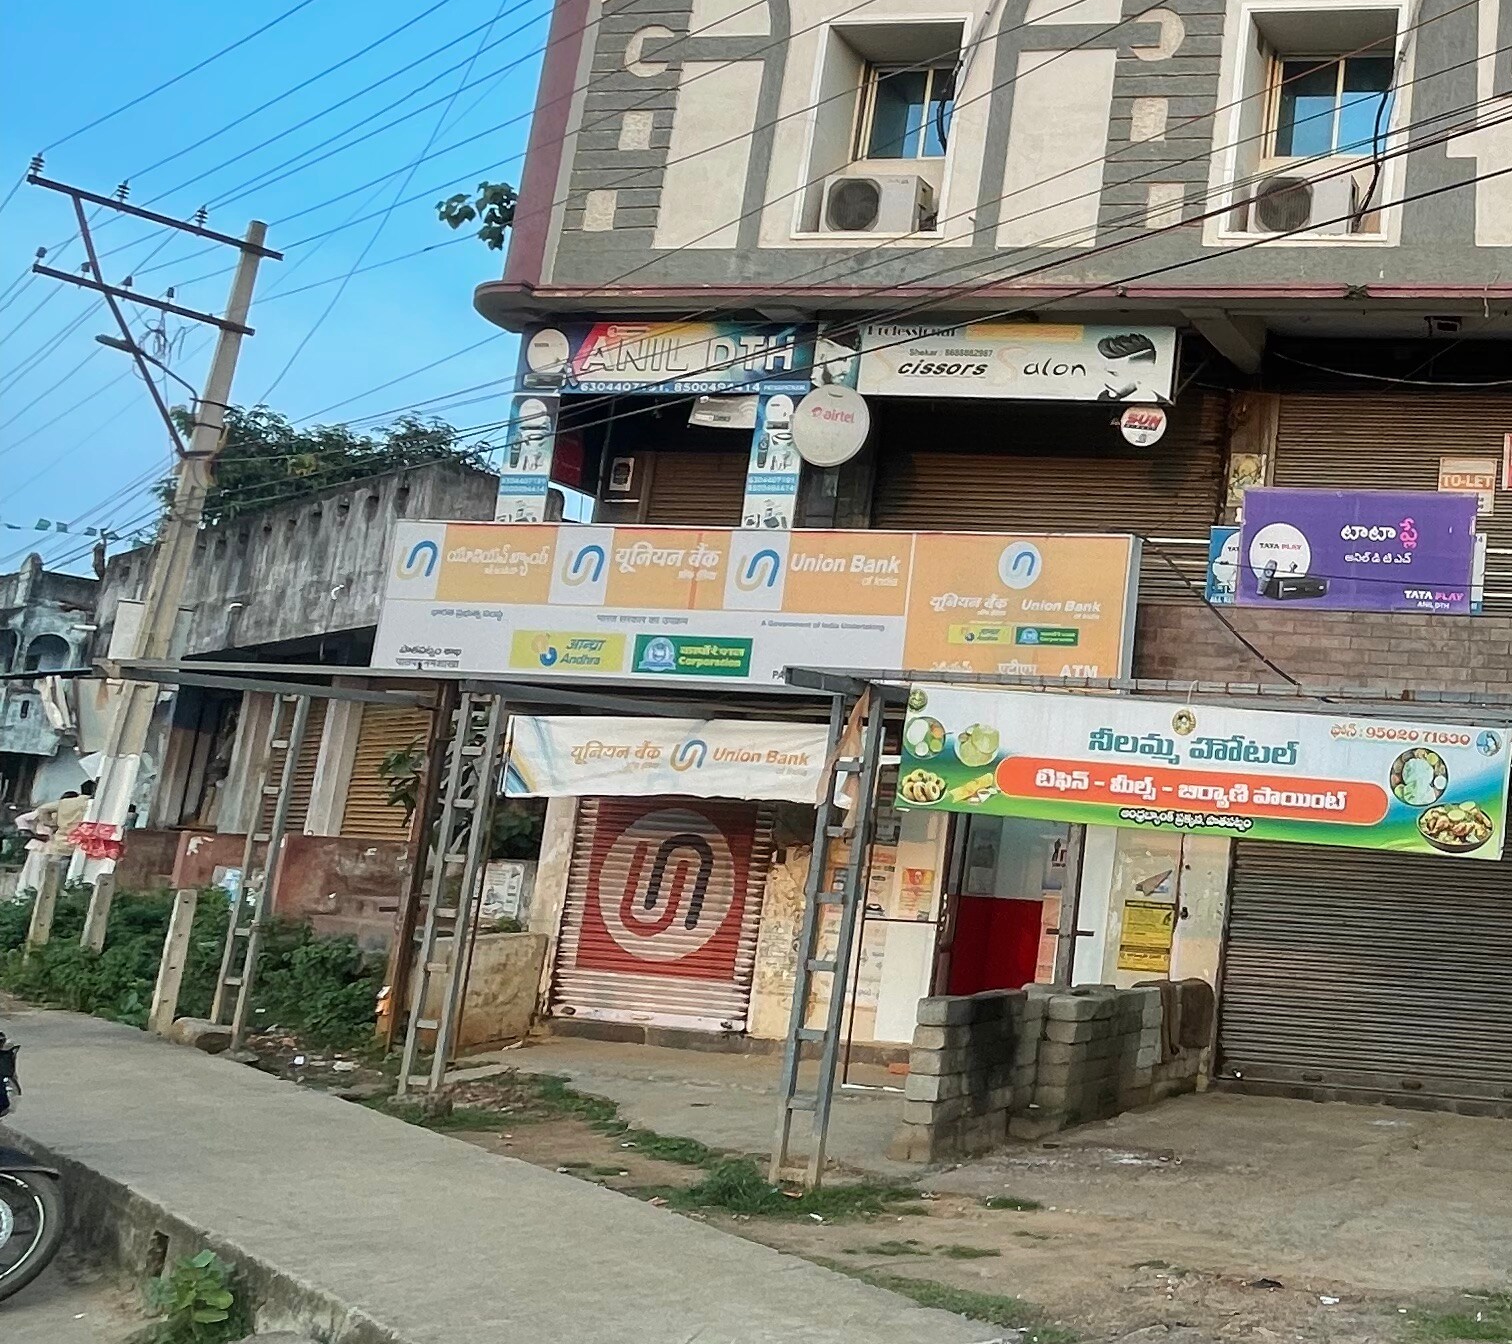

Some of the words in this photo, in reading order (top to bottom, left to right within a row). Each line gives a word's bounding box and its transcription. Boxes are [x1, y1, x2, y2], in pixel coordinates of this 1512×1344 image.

[580, 335, 689, 371] ANIL
[706, 334, 796, 371] DTH
[823, 409, 855, 423] airtel
[1441, 474, 1493, 488] TO-LET
[1341, 524, 1396, 541] టాటా
[1259, 542, 1280, 550] TATA
[614, 541, 685, 574] यूनियन
[688, 543, 723, 568] बैंक
[790, 552, 846, 573] Union
[850, 554, 901, 574] Bank
[861, 575, 873, 587] of
[874, 576, 898, 587] India
[929, 592, 982, 612] यूनियन
[984, 593, 1009, 609] बैंक
[1404, 590, 1433, 600] TATA
[1434, 592, 1464, 601] PLAY
[1021, 599, 1061, 612] Union
[1064, 600, 1101, 613] Bank
[560, 652, 601, 666] Andhra
[1059, 664, 1099, 677] ATM
[1366, 727, 1419, 742] 95020
[570, 740, 629, 765] यूनियन
[634, 740, 664, 759] बैंक
[1088, 728, 1181, 765] నీలమ్మ
[1188, 734, 1300, 766] హోటల్
[712, 748, 761, 763] Union
[763, 750, 810, 766] Bank
[1035, 767, 1090, 791] టిఫిన్
[1109, 773, 1157, 801] మీల్స్
[1252, 786, 1348, 811] పాయింట్
